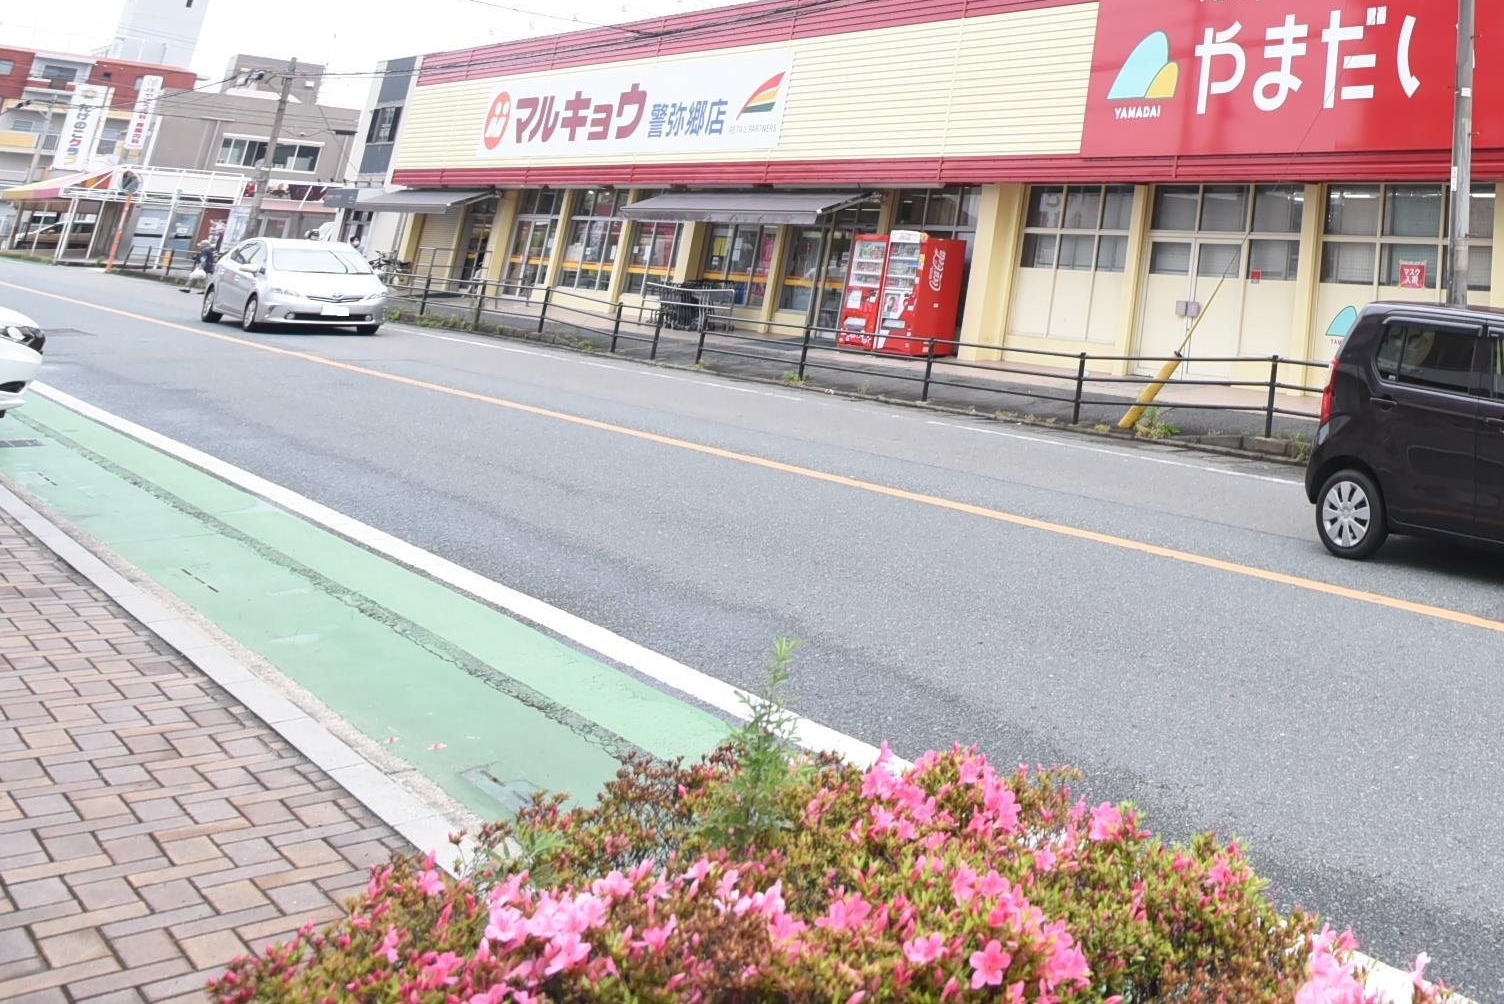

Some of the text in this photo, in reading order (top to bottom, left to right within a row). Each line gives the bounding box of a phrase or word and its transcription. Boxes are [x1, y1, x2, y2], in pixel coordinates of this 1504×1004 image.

[515, 82, 729, 144] マルキョウ 警弥郷店
[1114, 104, 1161, 119] YAMADAI
[1403, 268, 1421, 276] マスク
